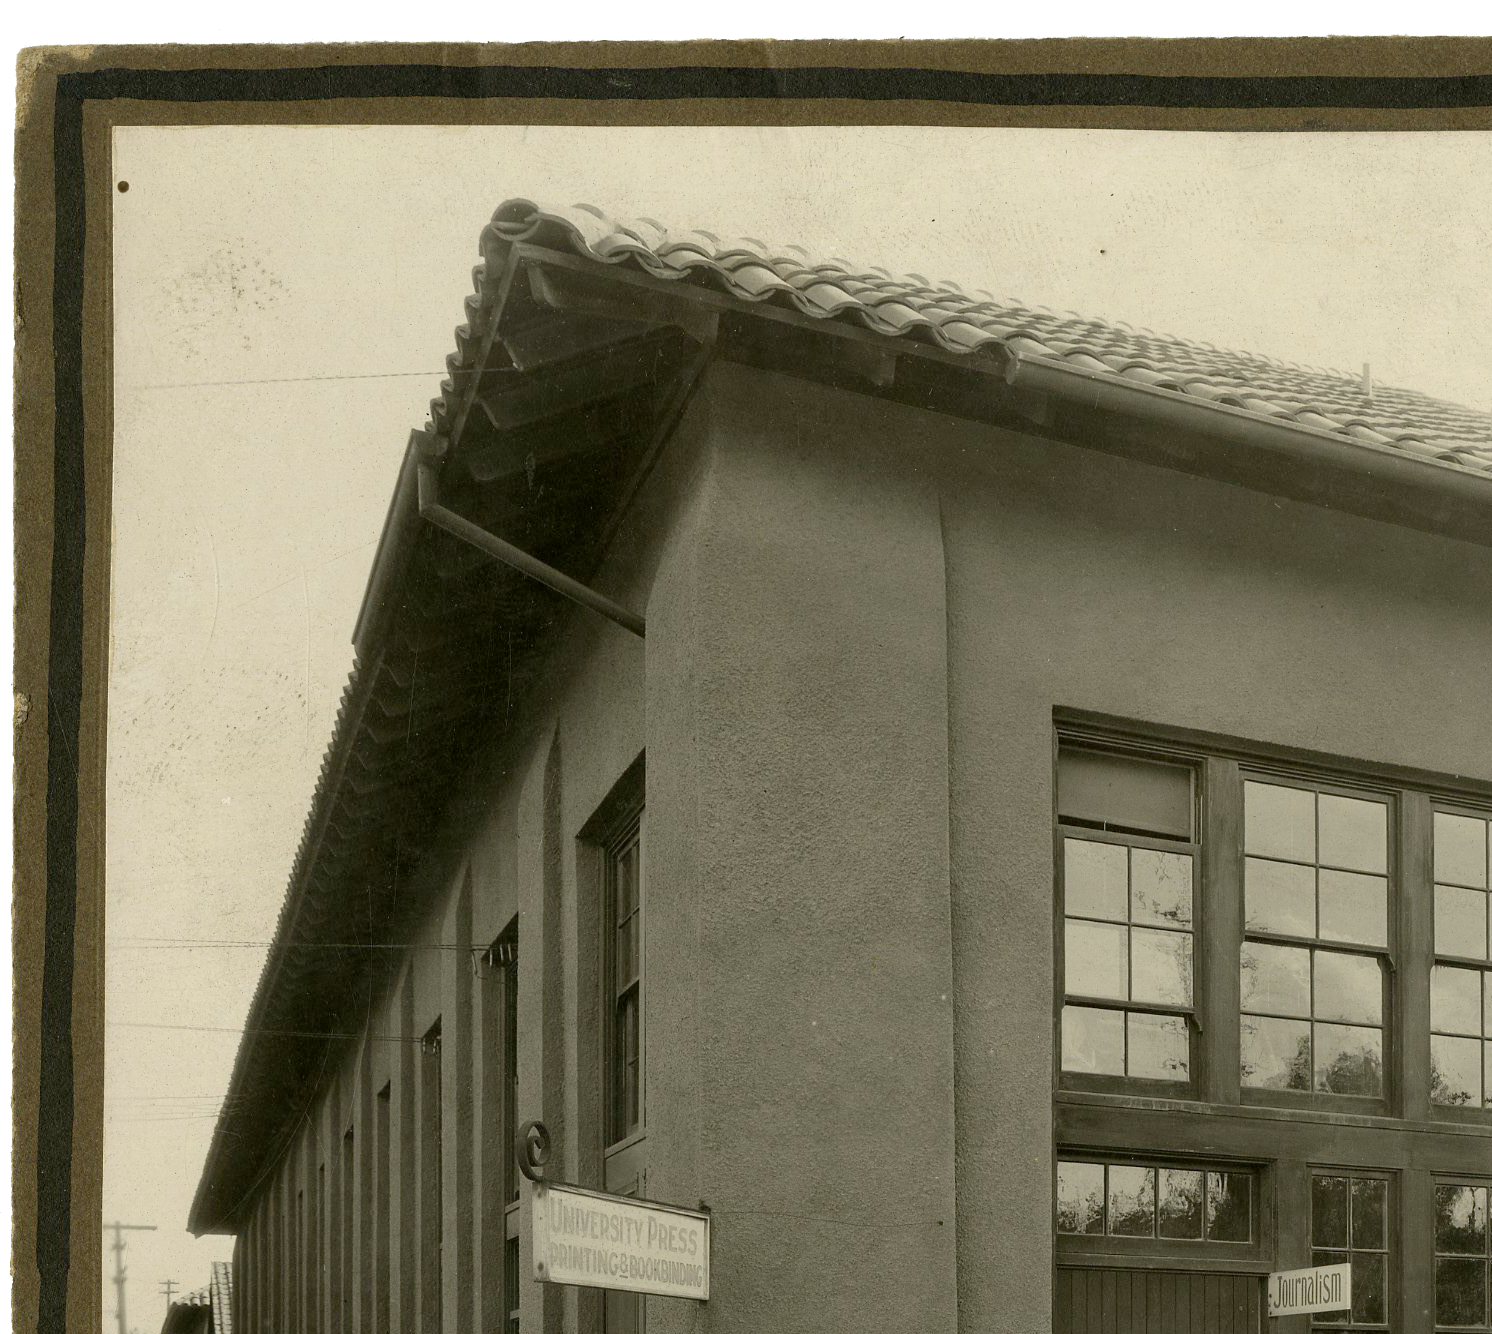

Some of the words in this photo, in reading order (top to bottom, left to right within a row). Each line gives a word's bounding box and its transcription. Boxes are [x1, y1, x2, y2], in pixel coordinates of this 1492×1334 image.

[548, 1197, 643, 1249] UNIVERSITY
[647, 1215, 698, 1256] PRESS
[1273, 1271, 1341, 1309] Journalism
